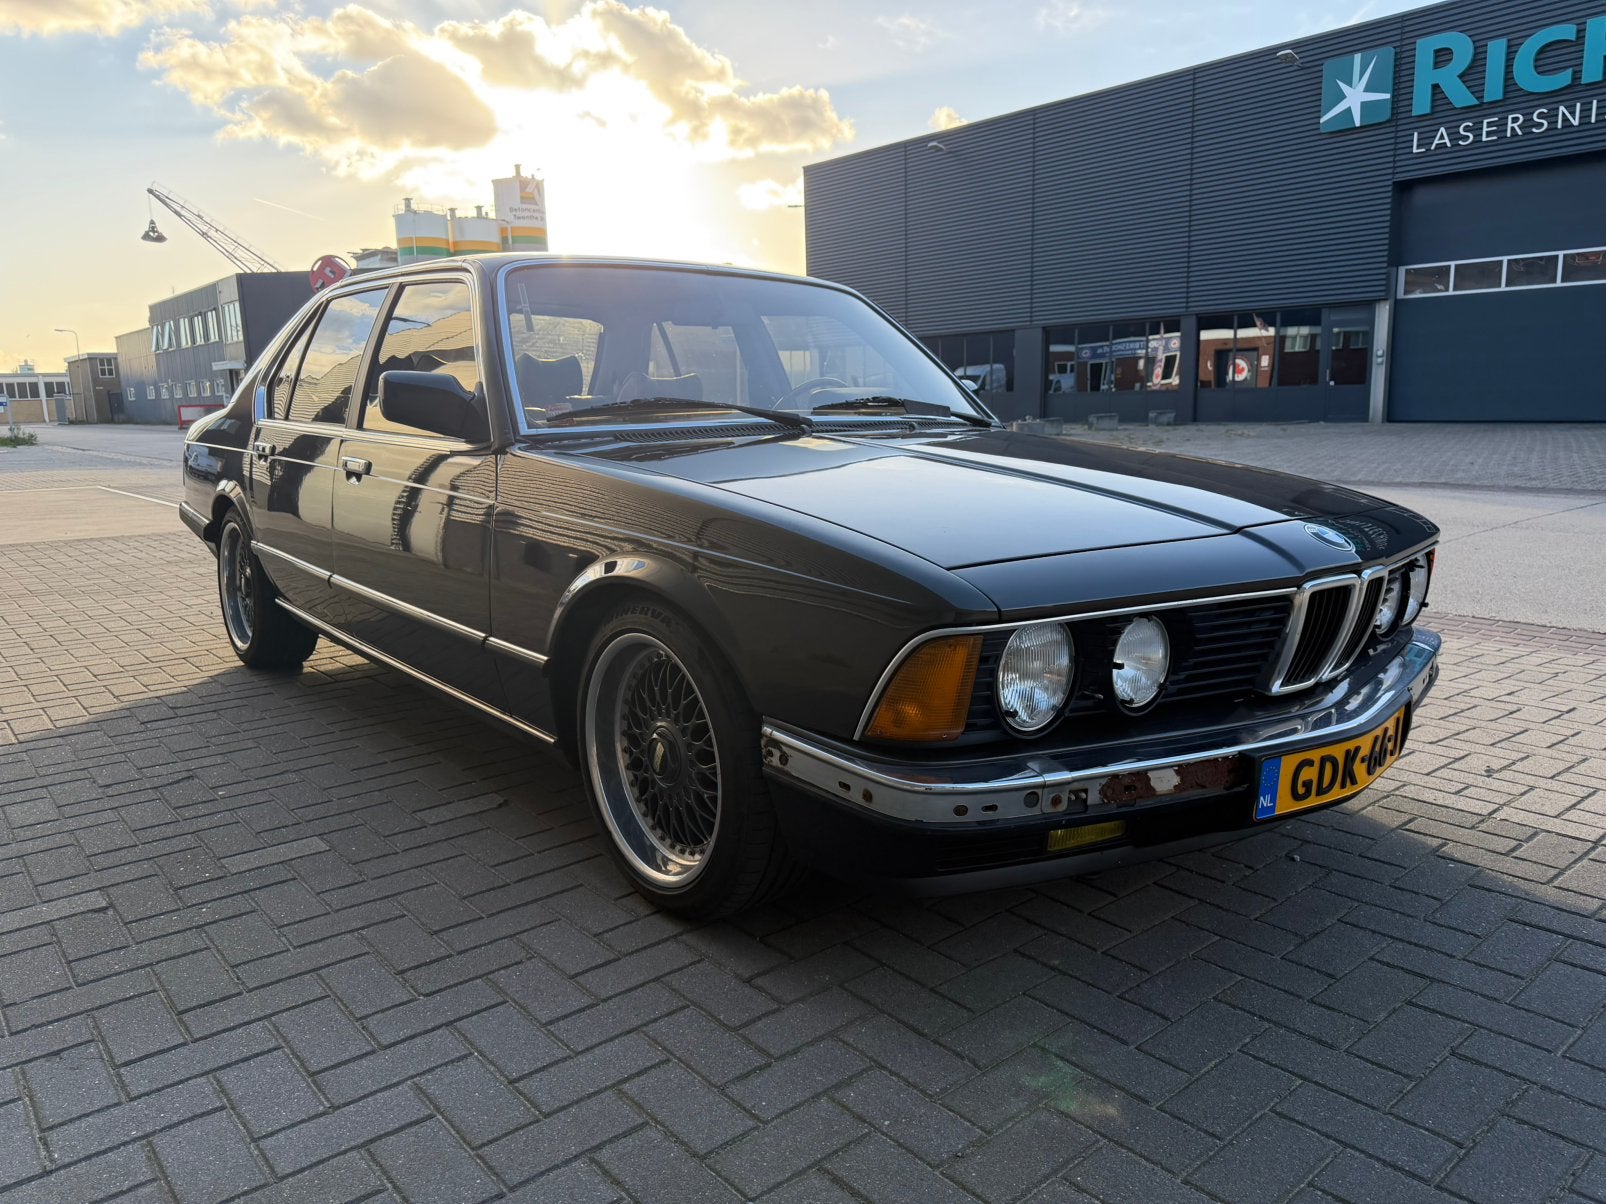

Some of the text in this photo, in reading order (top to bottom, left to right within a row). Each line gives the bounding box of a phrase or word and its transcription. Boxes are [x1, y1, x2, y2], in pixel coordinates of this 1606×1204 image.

[1412, 99, 1606, 153] LASERSNI
[1290, 716, 1401, 802] GDK-66-J
[1258, 794, 1274, 809] NL
